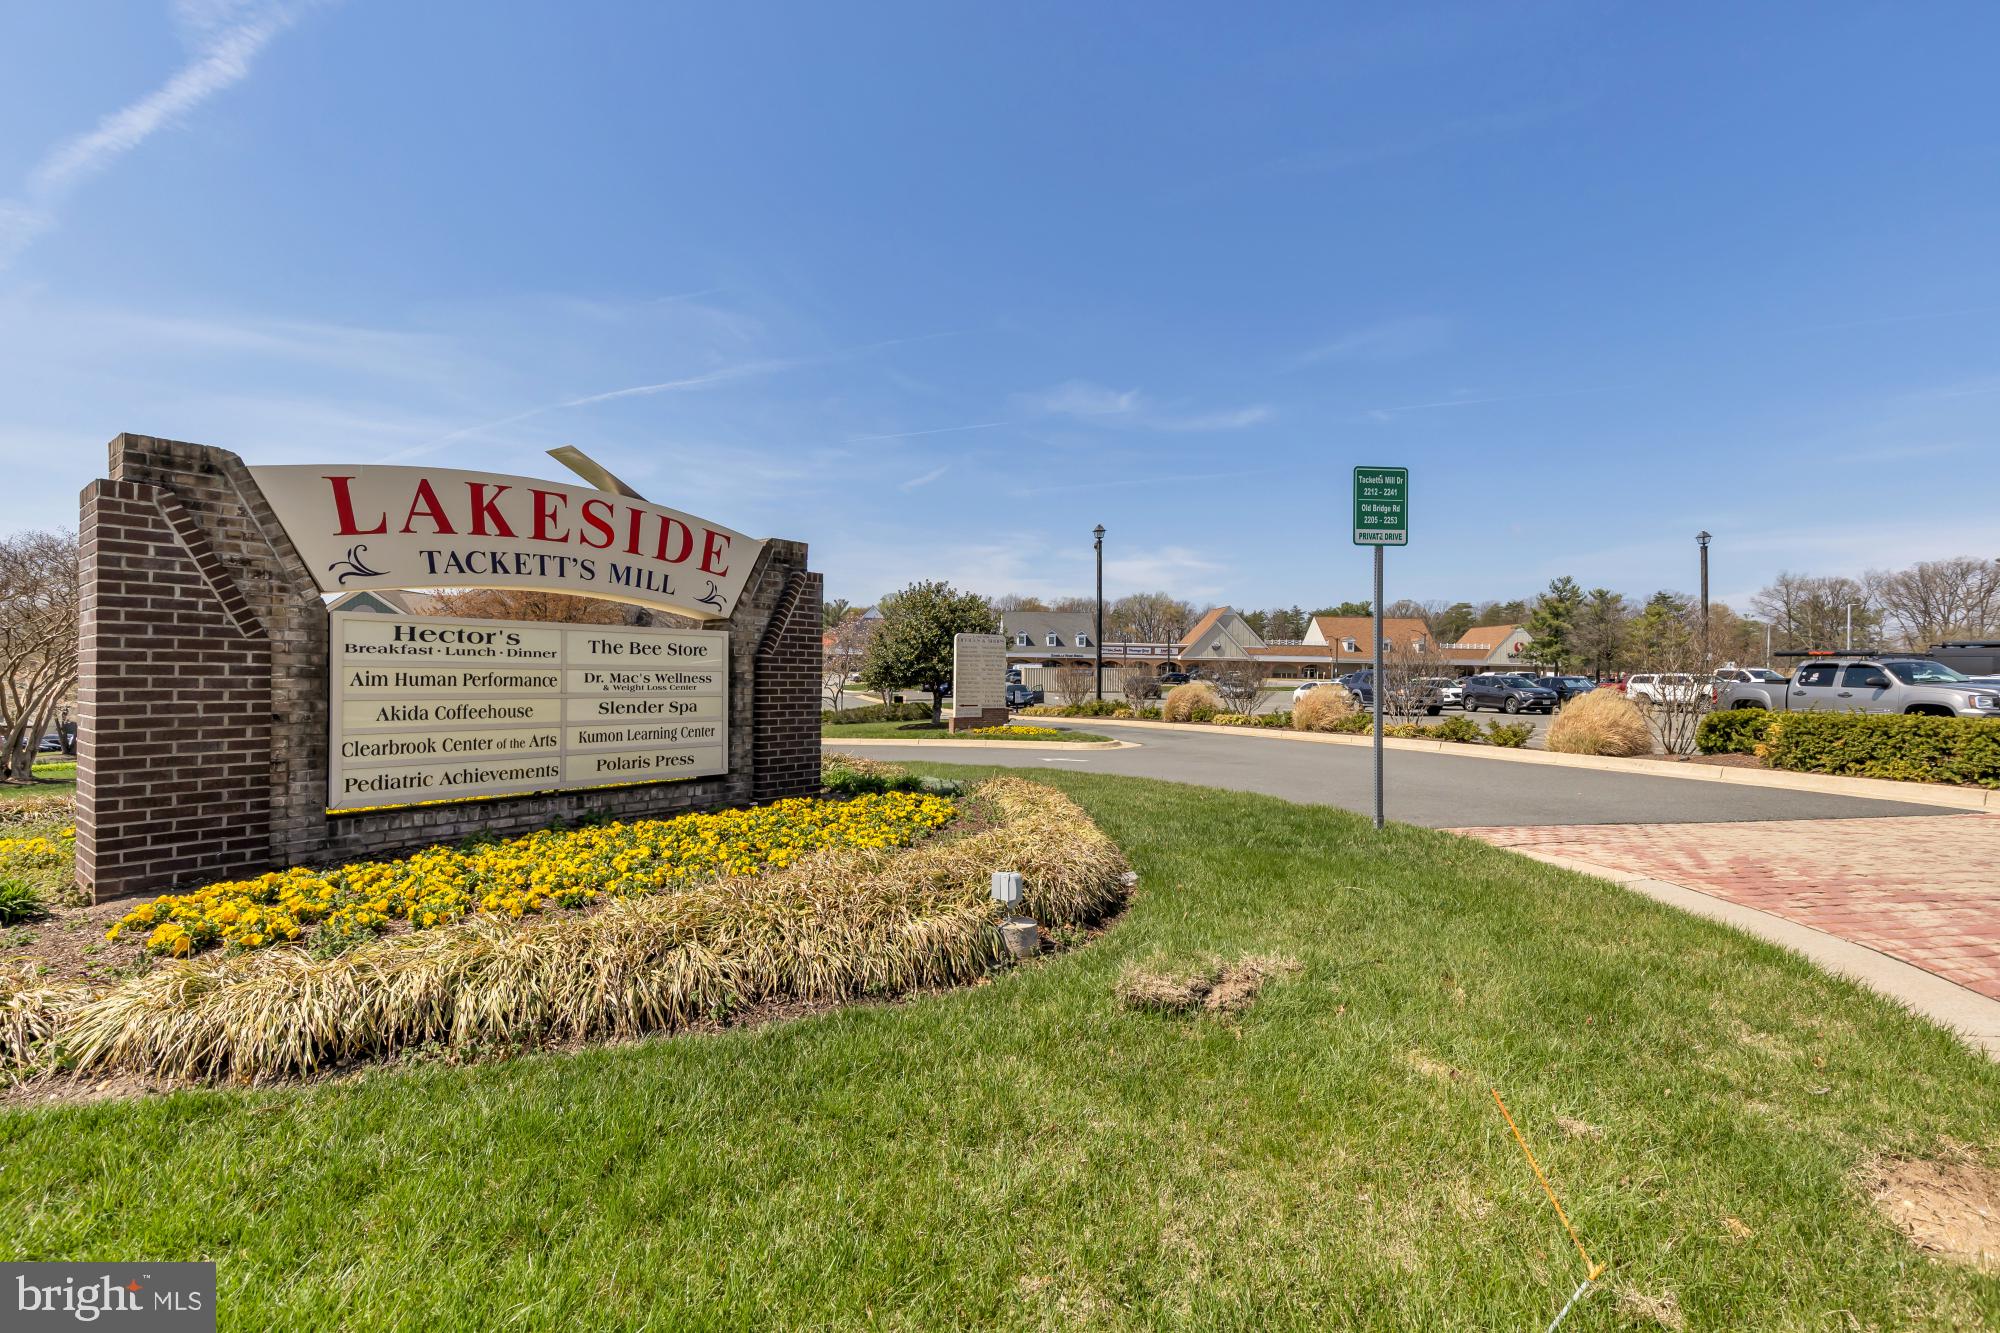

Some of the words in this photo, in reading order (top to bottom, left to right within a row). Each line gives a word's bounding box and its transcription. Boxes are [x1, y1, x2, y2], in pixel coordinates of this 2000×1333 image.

[1385, 476, 1395, 484] Mill
[1364, 488, 1378, 496] 2212
[1384, 488, 1397, 496] 2241
[1372, 504, 1390, 513] Bridge
[322, 476, 732, 578] LAKESIDE
[1384, 516, 1397, 524] 2253
[419, 550, 596, 581] TACKETT'S
[608, 562, 676, 596] MILL
[394, 626, 520, 646] Hector's
[345, 644, 434, 656] Breakfast
[446, 646, 496, 657] Lunch
[507, 649, 557, 658] Dinner
[588, 640, 623, 654] The
[630, 642, 662, 656] Bee
[667, 643, 707, 657] Store
[350, 670, 388, 687] Aim
[395, 672, 457, 687] Human
[462, 672, 558, 688] Performance
[584, 673, 604, 683] Dr.
[610, 673, 650, 684] Mac's
[656, 674, 712, 684] Wellness
[613, 684, 644, 692] Weight
[376, 706, 429, 722] Akida
[435, 704, 534, 720] Coffeehouse
[599, 701, 664, 715] Slender
[669, 701, 697, 715] Spa
[579, 731, 623, 743] Kumon
[627, 727, 677, 742] Learning
[681, 726, 715, 738] Center
[342, 738, 436, 757] Clearbrook
[442, 732, 492, 752] Center
[496, 738, 507, 749] of
[510, 738, 526, 749] the
[529, 734, 557, 748] Arts
[596, 756, 650, 772] Polaris
[656, 754, 694, 767] Press
[344, 772, 434, 793] Pediatric
[440, 764, 559, 785] Achievements
